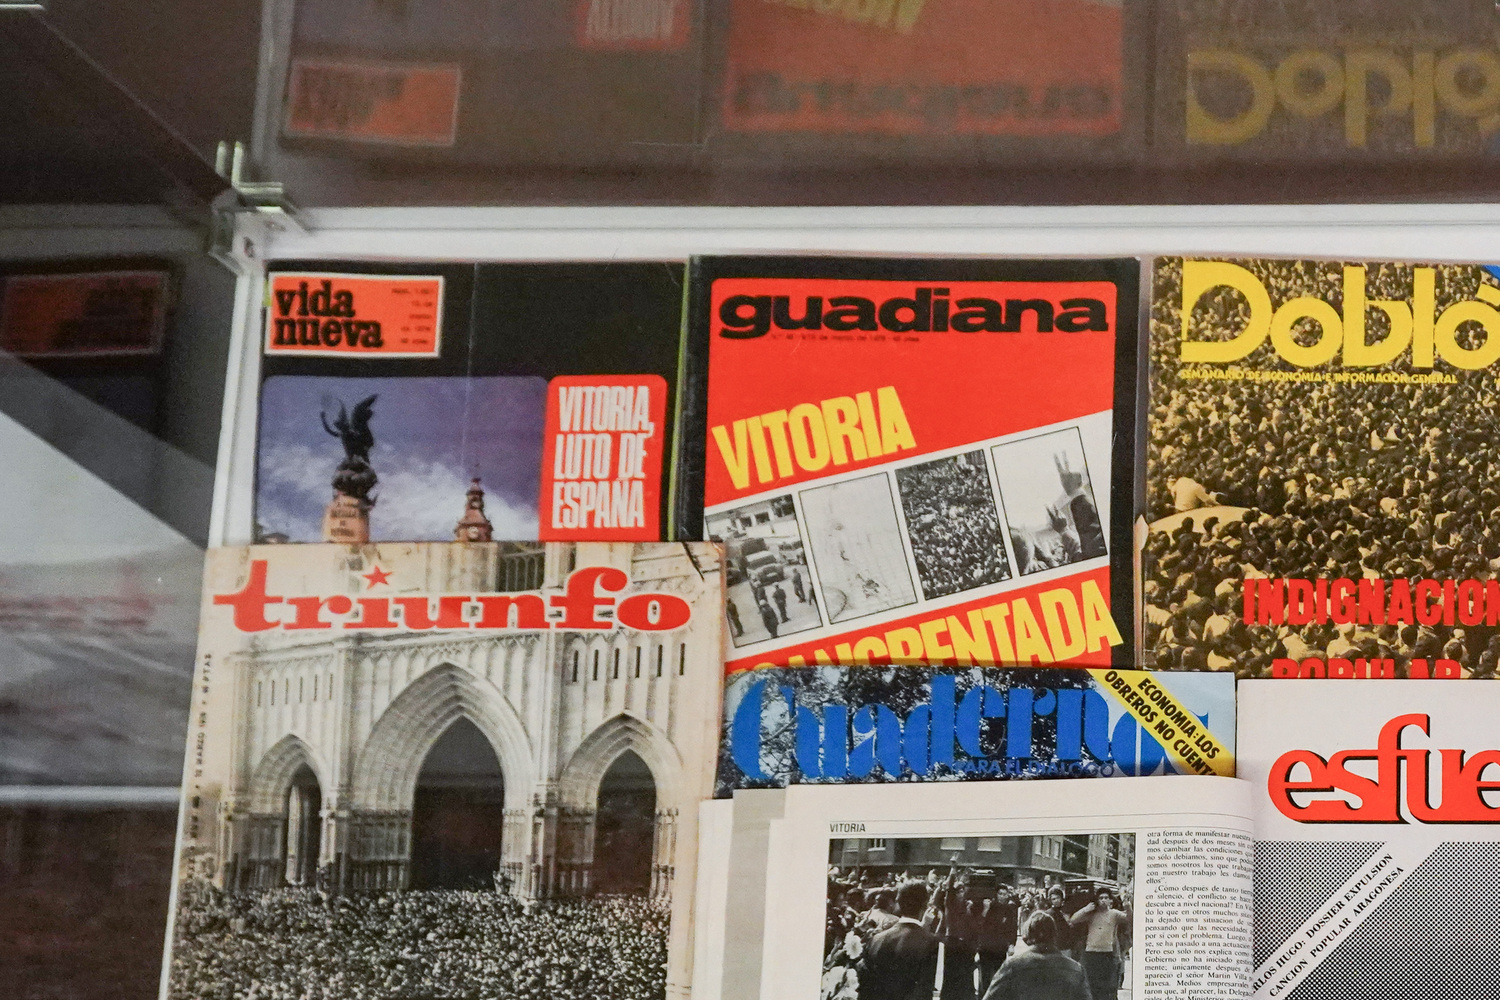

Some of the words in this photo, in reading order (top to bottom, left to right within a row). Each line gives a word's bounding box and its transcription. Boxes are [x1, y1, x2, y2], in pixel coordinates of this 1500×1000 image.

[275, 280, 355, 317] vida
[719, 287, 1109, 339] guadiana
[274, 318, 384, 347] nueva
[559, 385, 654, 437] VITORIA,
[712, 386, 916, 490] VITORIA
[555, 434, 609, 480] LUTO
[619, 433, 647, 480] DE
[214, 560, 690, 632] triunfo
[1104, 670, 1159, 723] OBREROS
[1154, 720, 1175, 742] NO
[1137, 677, 1199, 739] ECONOMIA:
[1196, 735, 1220, 759] LOS
[829, 823, 866, 833] VITORIA
[1269, 959, 1309, 997] CANCION
[1309, 917, 1352, 958] POPULAR
[1352, 866, 1404, 916] ARAGONESA
[1276, 940, 1306, 968] HUGO:
[1305, 901, 1346, 938] DOSSIER
[1344, 854, 1393, 902] EXPULSION
